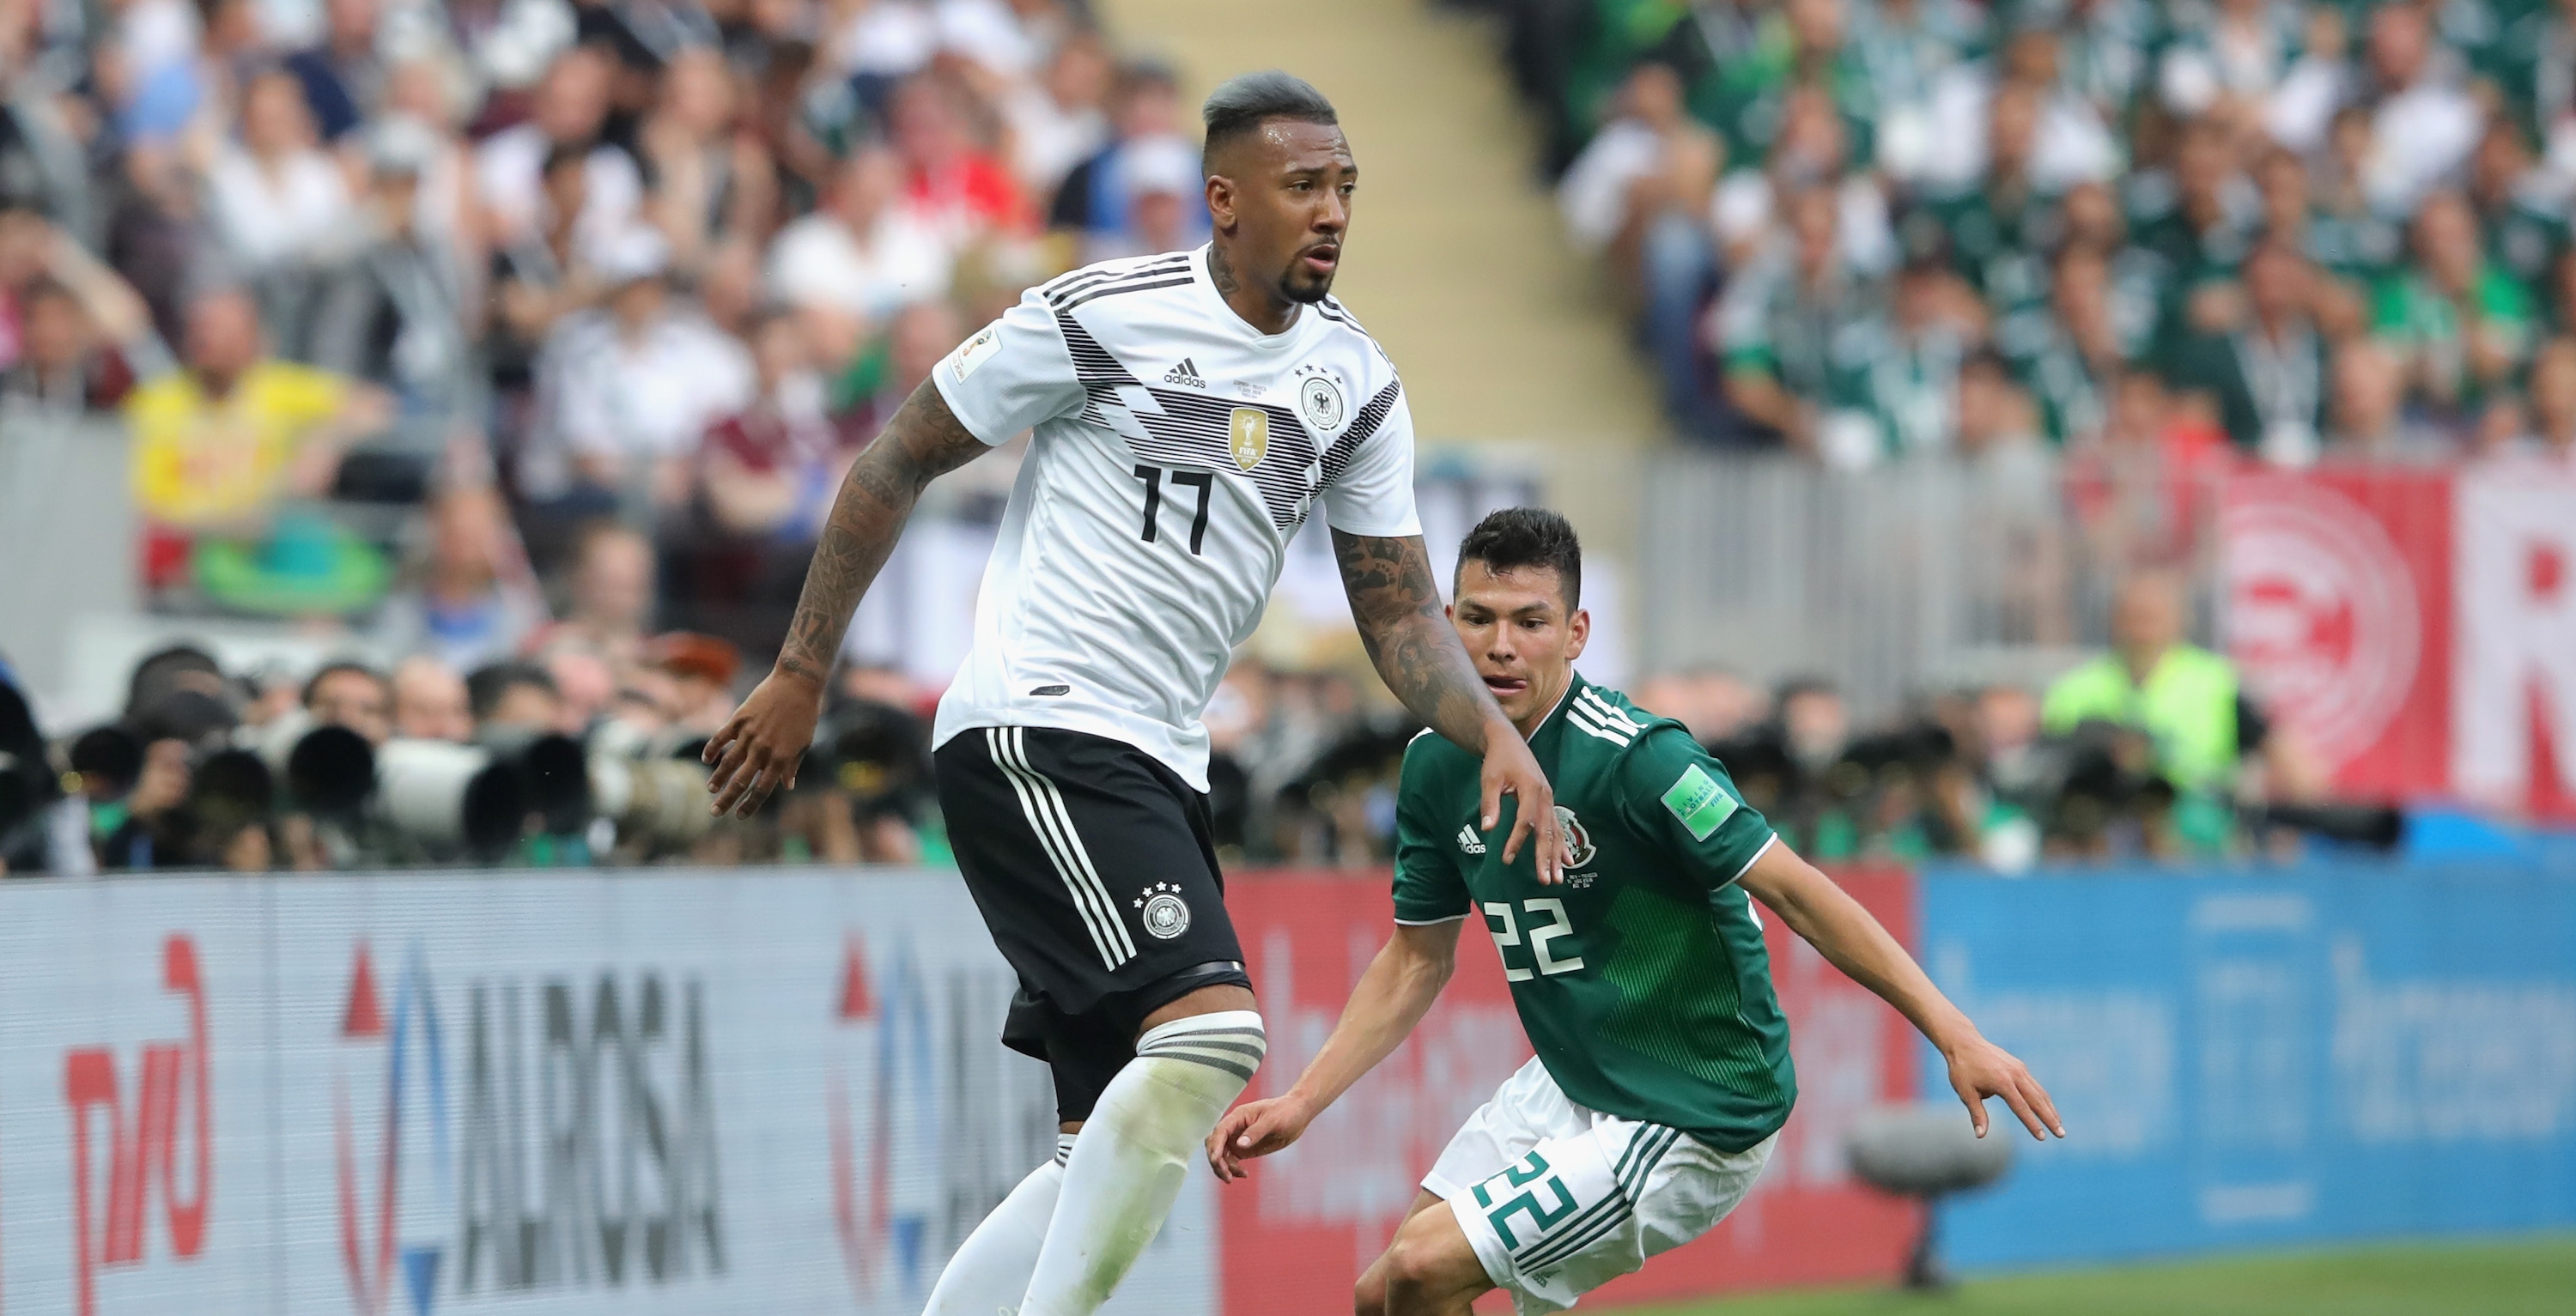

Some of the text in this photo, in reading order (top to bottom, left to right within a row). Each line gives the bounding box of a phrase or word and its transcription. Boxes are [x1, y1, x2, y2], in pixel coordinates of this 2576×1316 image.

[1163, 374, 1206, 389] adidas
[1239, 446, 1257, 456] FIFA
[1133, 464, 1214, 556] 17
[1676, 779, 1710, 813] LIVING
[1710, 792, 1724, 808] FIFA
[1484, 898, 1585, 982] 22
[1471, 1149, 1579, 1252] 22
